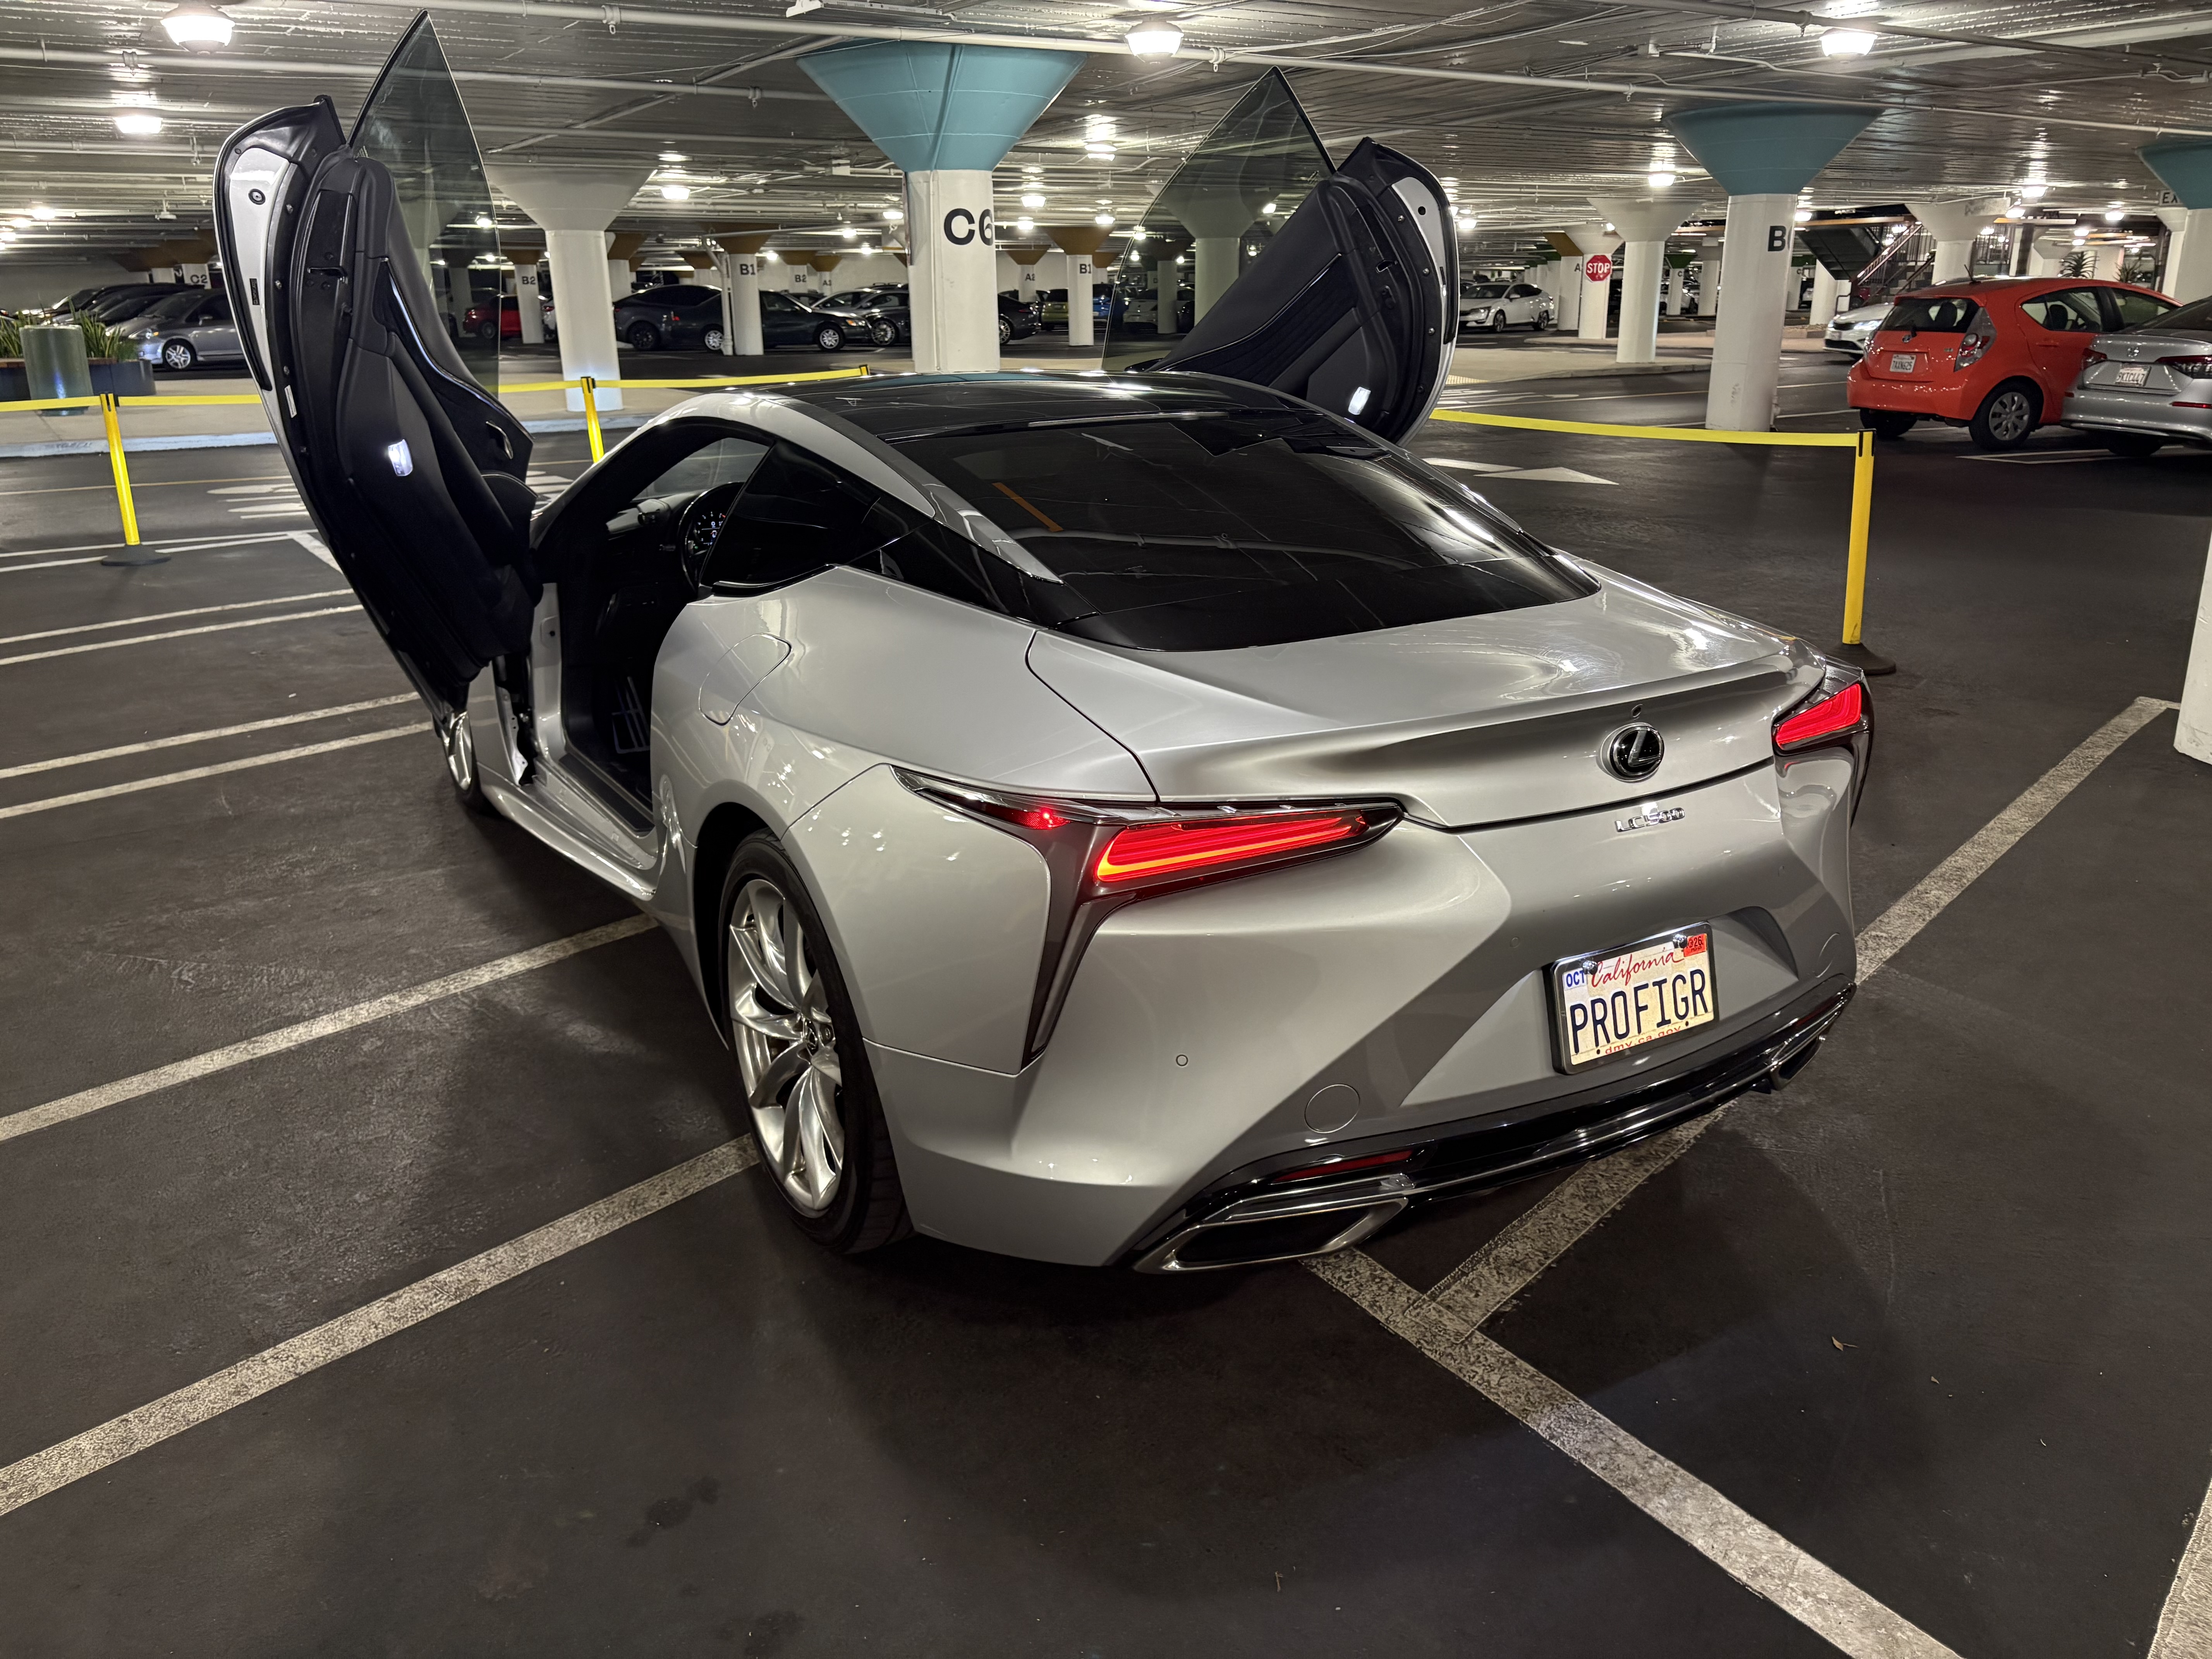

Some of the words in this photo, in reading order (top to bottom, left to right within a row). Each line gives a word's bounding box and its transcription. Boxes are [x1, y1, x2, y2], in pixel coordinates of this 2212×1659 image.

[2162, 192, 2178, 203] EX
[944, 208, 993, 246] C6
[740, 264, 756, 275] B1
[1079, 264, 1091, 274] B1
[1574, 263, 1580, 271] A
[1587, 263, 1610, 273] STOP
[190, 274, 208, 283] C2
[522, 276, 536, 285] B2
[1592, 947, 1685, 988] California
[1566, 970, 1585, 987] OCT
[1570, 969, 1708, 1054] PROFIGR
[1605, 1025, 1681, 1054] dmv.ca.gov
